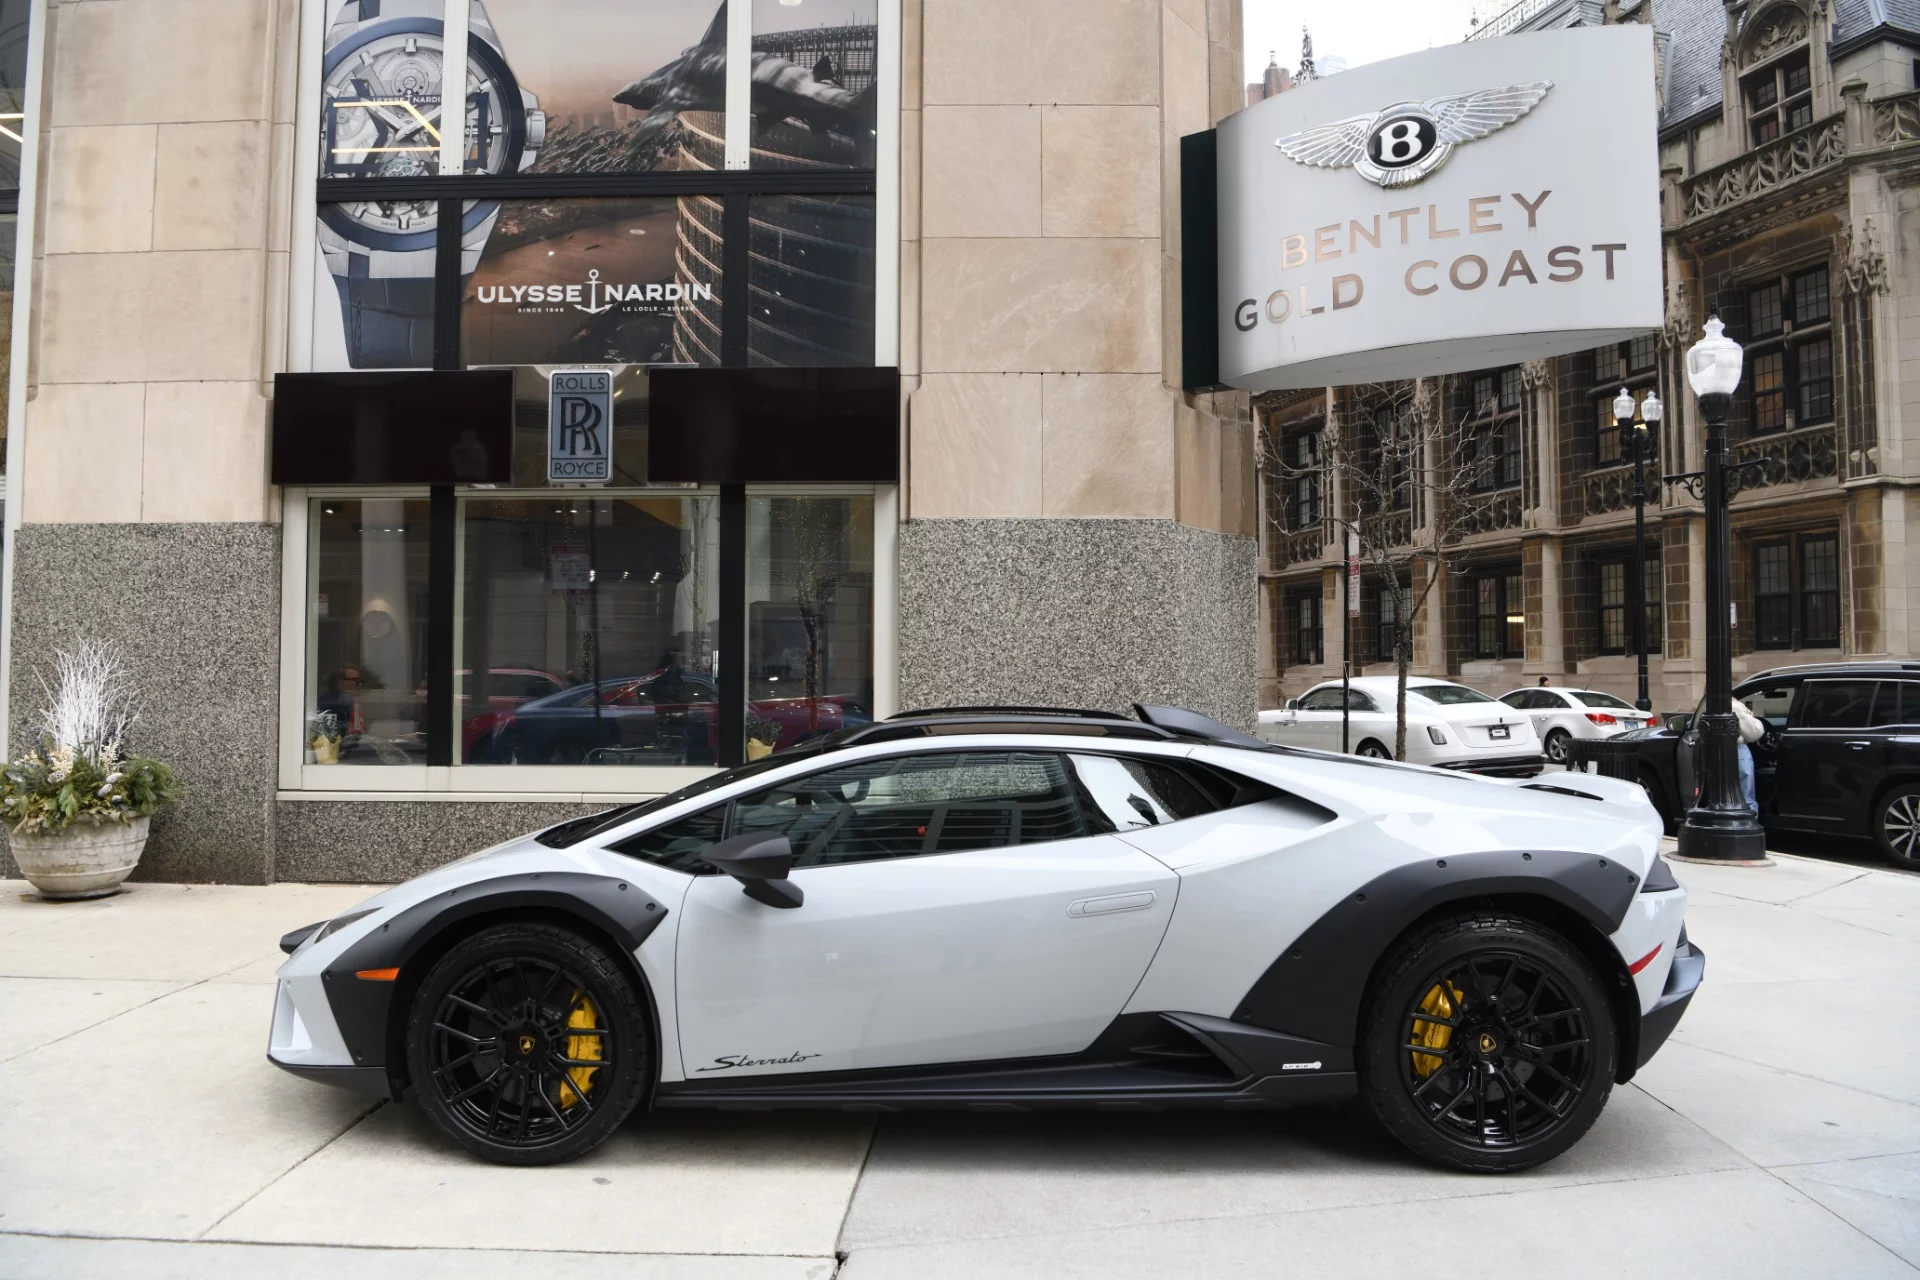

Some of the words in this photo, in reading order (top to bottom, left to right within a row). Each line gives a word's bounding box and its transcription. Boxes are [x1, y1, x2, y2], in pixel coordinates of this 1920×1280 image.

[1380, 119, 1423, 163] B
[1281, 190, 1552, 271] BENTLEY
[477, 284, 582, 303] ULYSSE
[604, 283, 711, 302] NARDIN
[1234, 273, 1364, 332] GOLD
[1404, 243, 1627, 296] COAST
[556, 377, 605, 390] ROLLS
[554, 462, 604, 475] ROYCE
[695, 1051, 823, 1072] Sterrato
